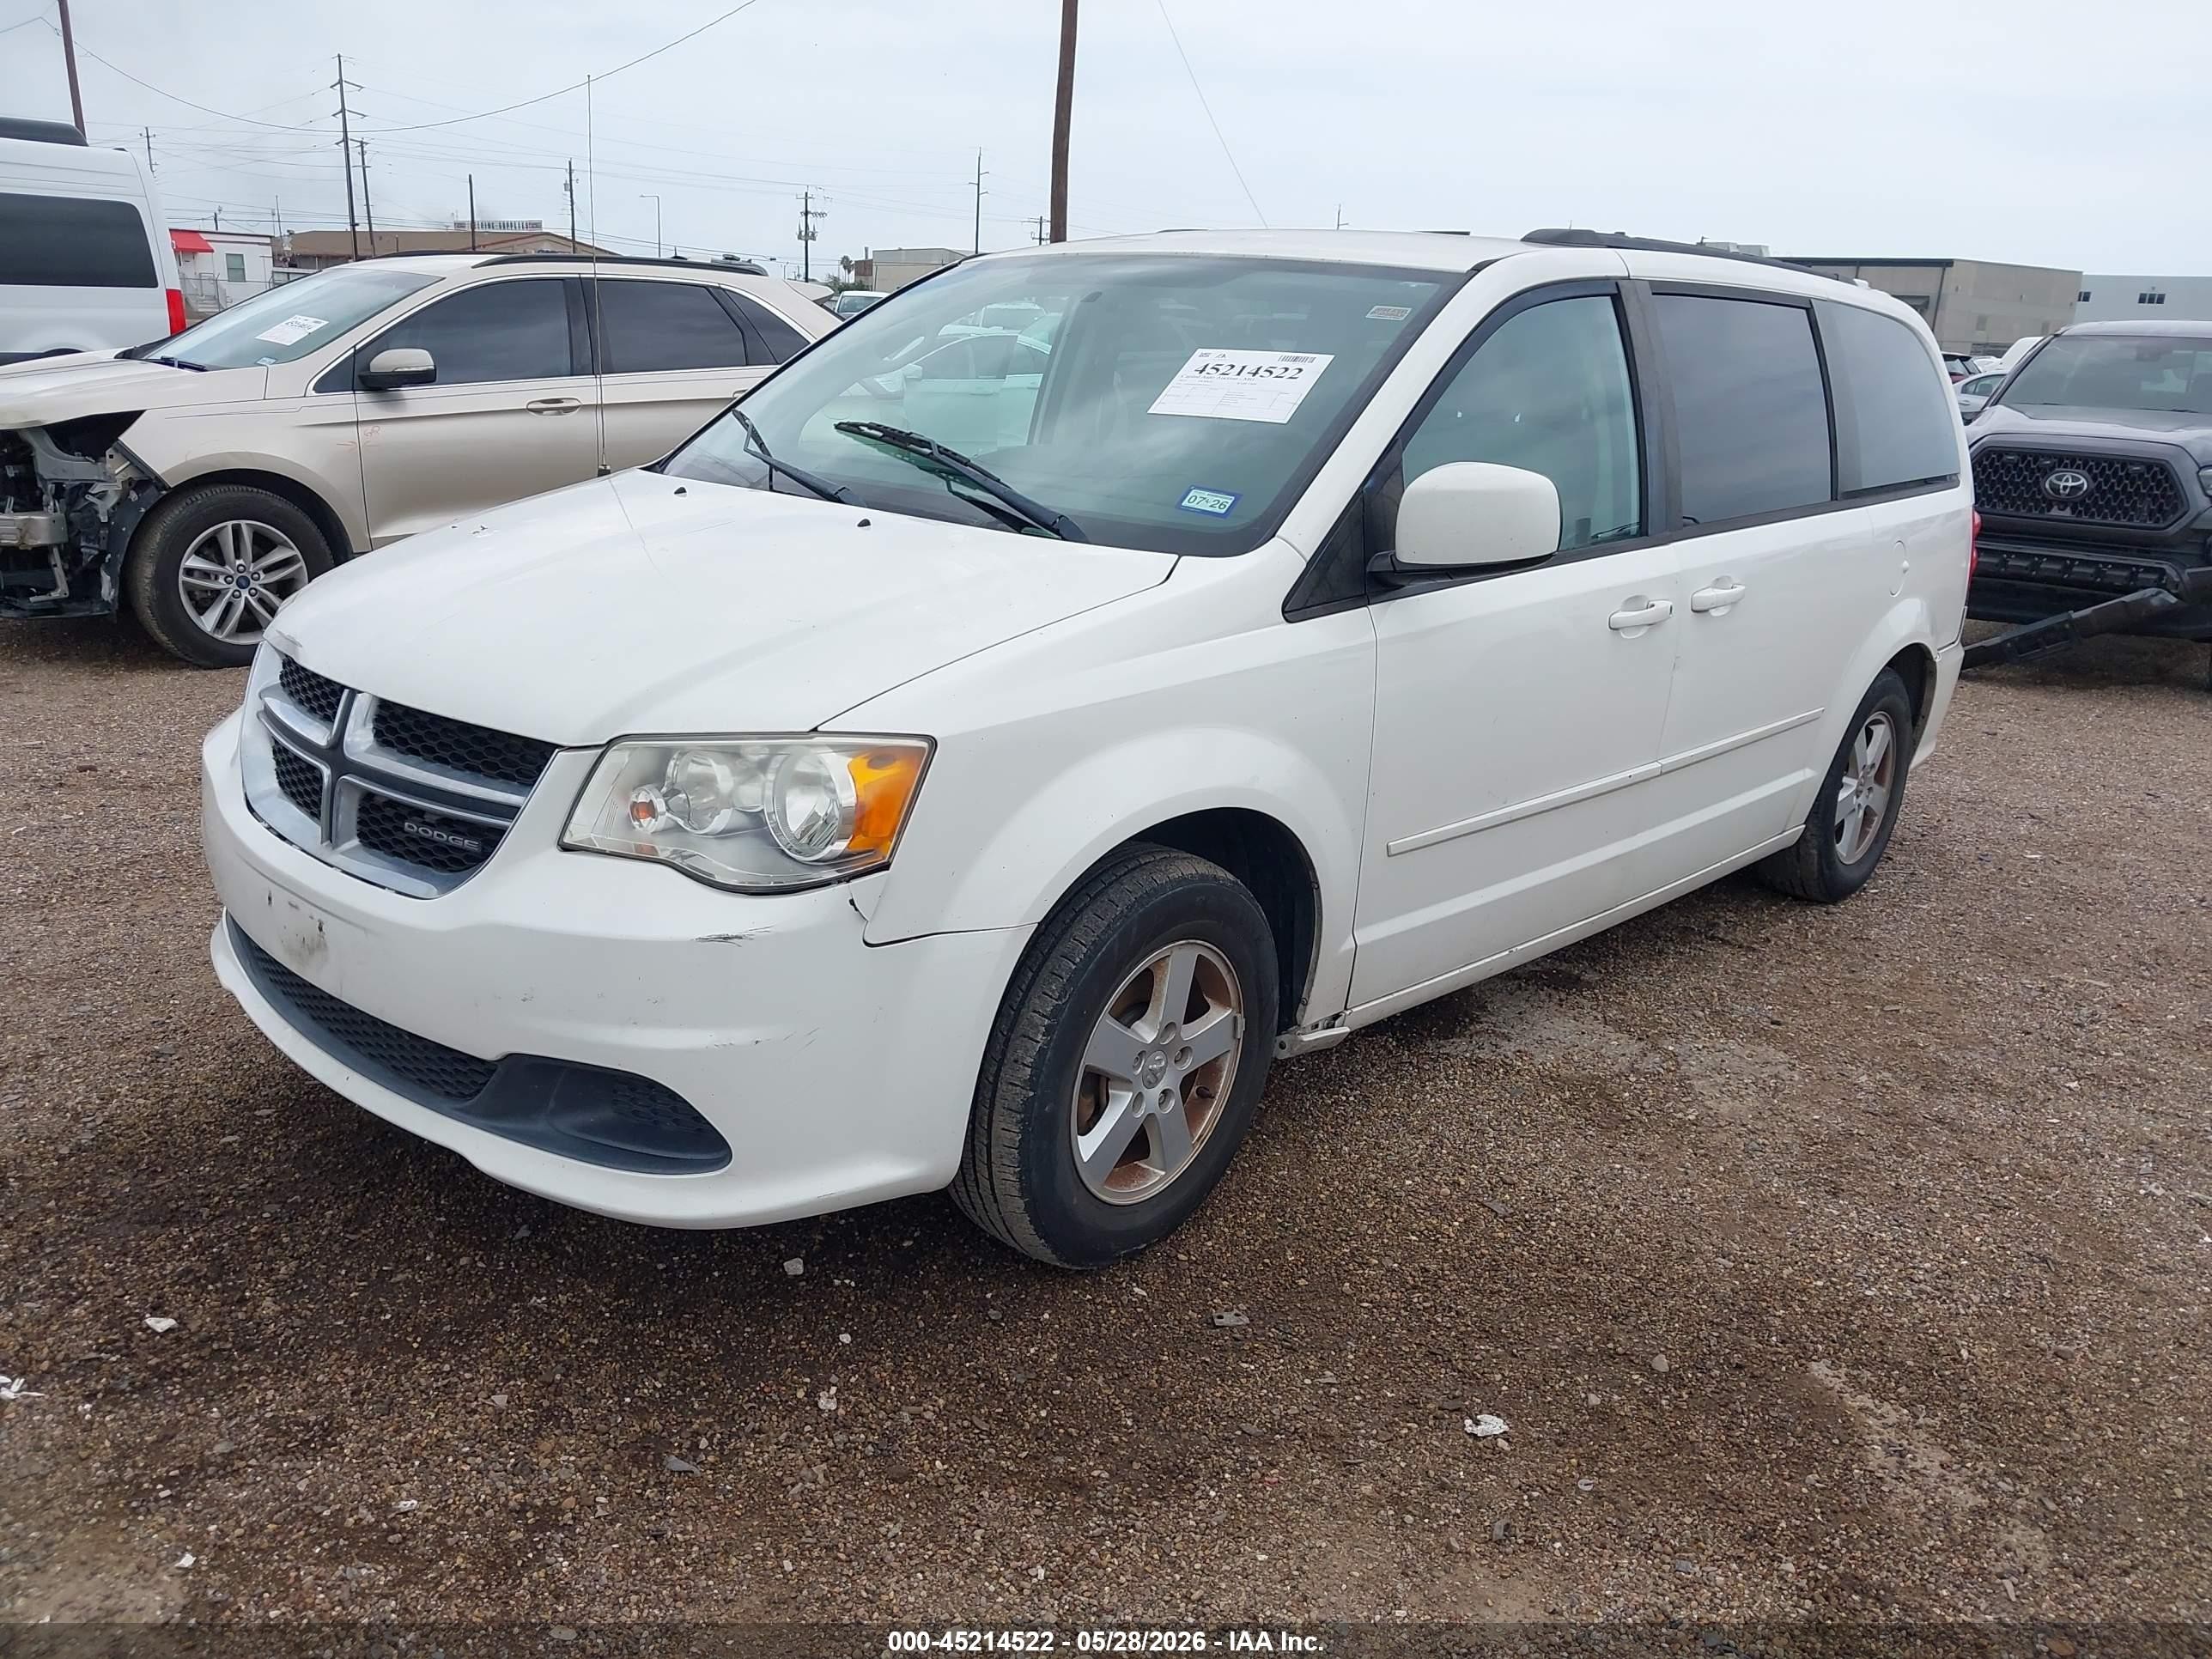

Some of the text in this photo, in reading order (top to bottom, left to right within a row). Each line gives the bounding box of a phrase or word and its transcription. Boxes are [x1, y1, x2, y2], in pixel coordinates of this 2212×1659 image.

[1194, 363, 1304, 380] 45214522
[1188, 495, 1229, 509] 07 26
[404, 822, 480, 851] DODGE
